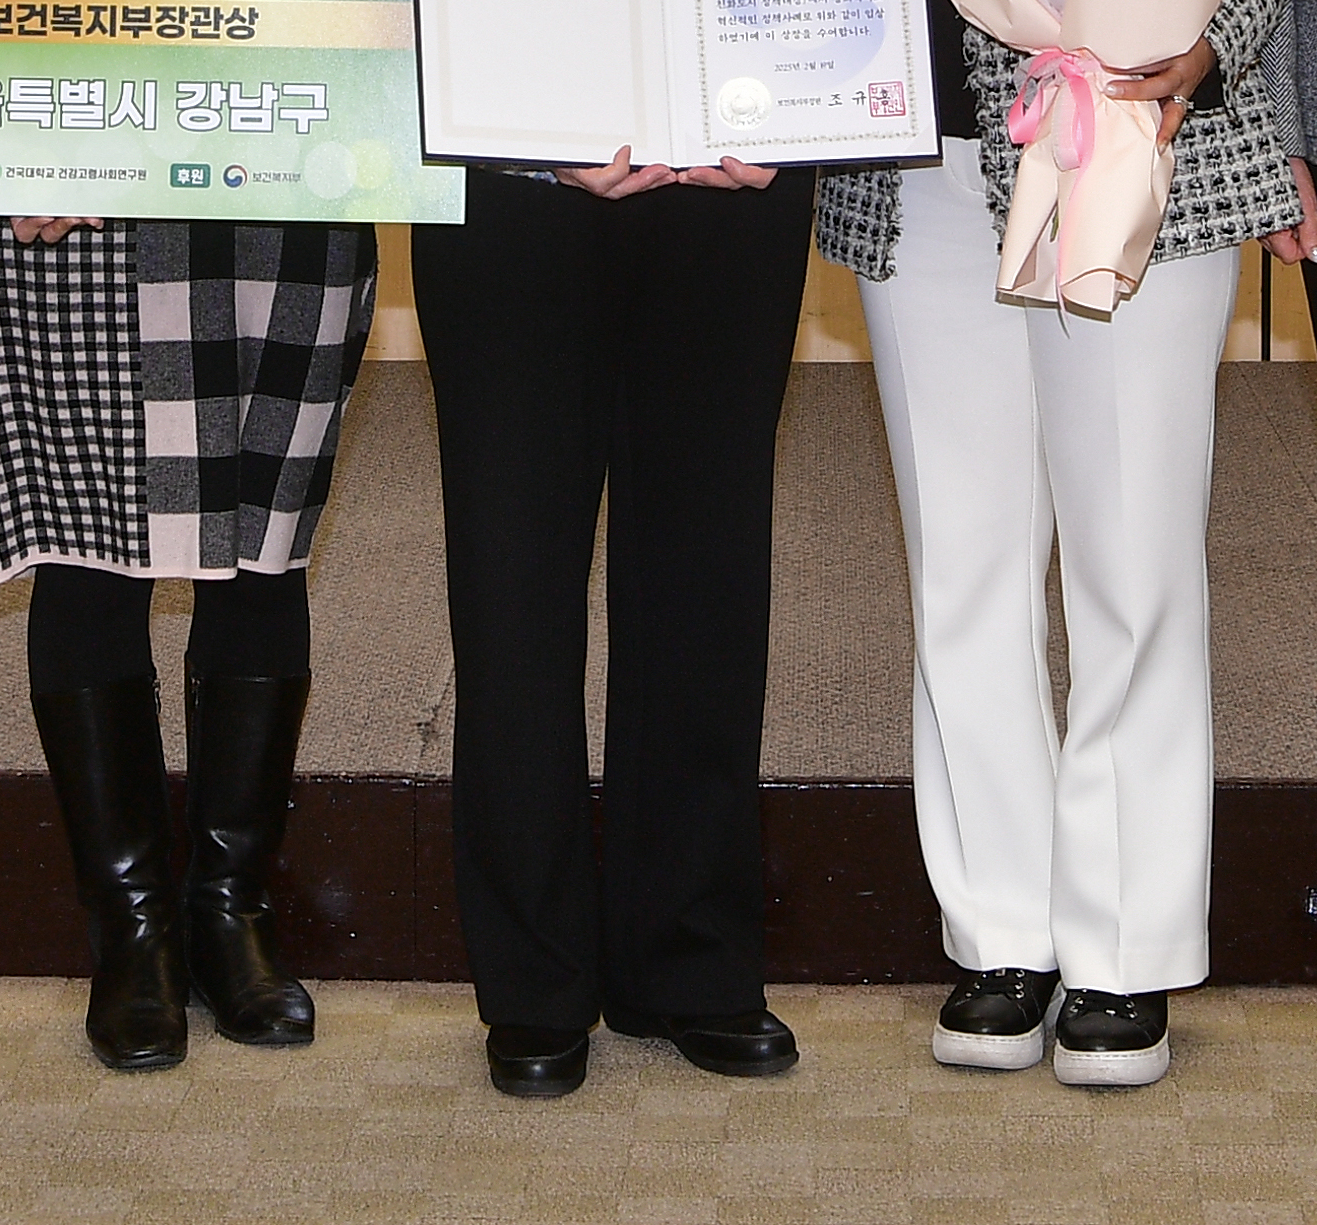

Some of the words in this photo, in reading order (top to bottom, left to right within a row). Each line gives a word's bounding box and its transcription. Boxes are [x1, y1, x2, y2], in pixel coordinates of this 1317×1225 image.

[766, 30, 775, 41] 이
[827, 93, 843, 107] 조
[851, 90, 867, 106] 규
[175, 81, 330, 134] 강남구
[5, 166, 55, 179] 건국대학교
[58, 167, 147, 182] 건강고령사회연구원
[177, 168, 204, 185] 후원
[252, 171, 302, 184] 보건복지부
